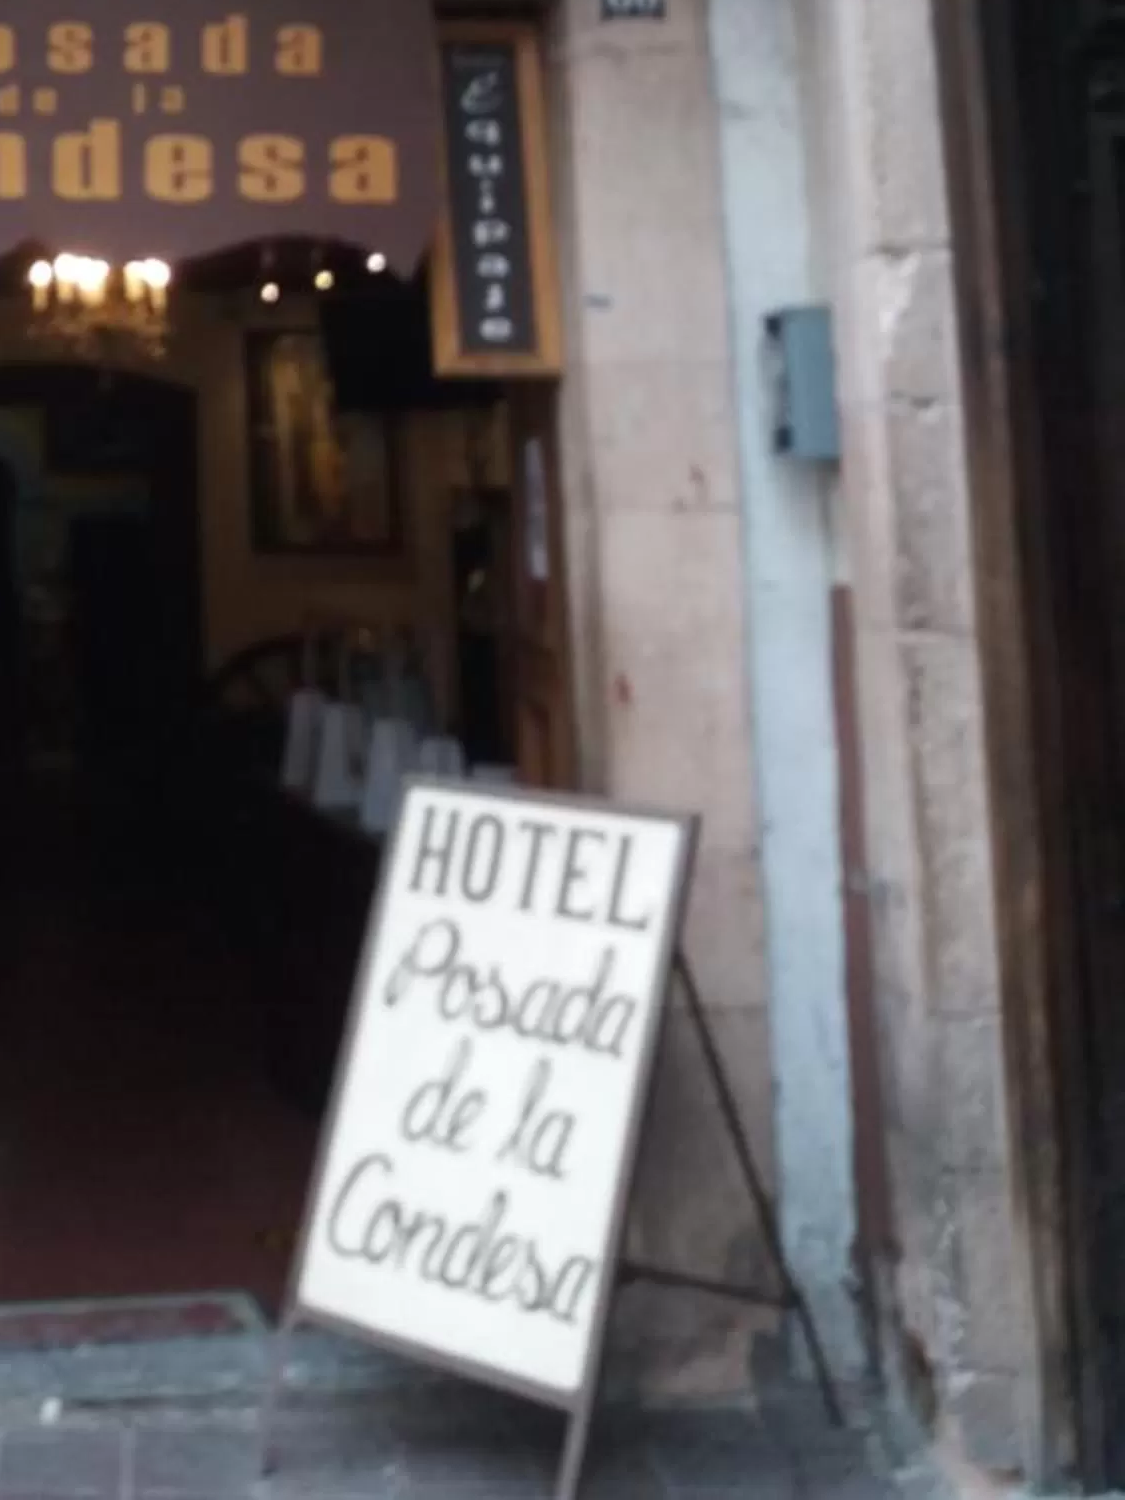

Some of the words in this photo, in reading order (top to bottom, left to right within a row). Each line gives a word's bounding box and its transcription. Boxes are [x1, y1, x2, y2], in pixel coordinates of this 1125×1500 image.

[132, 82, 186, 117] la
[406, 804, 651, 931] HOTEL
[382, 916, 637, 1060] Posada
[397, 1034, 488, 1155] de
[495, 1056, 577, 1182] la
[326, 1151, 598, 1325] Condesa
